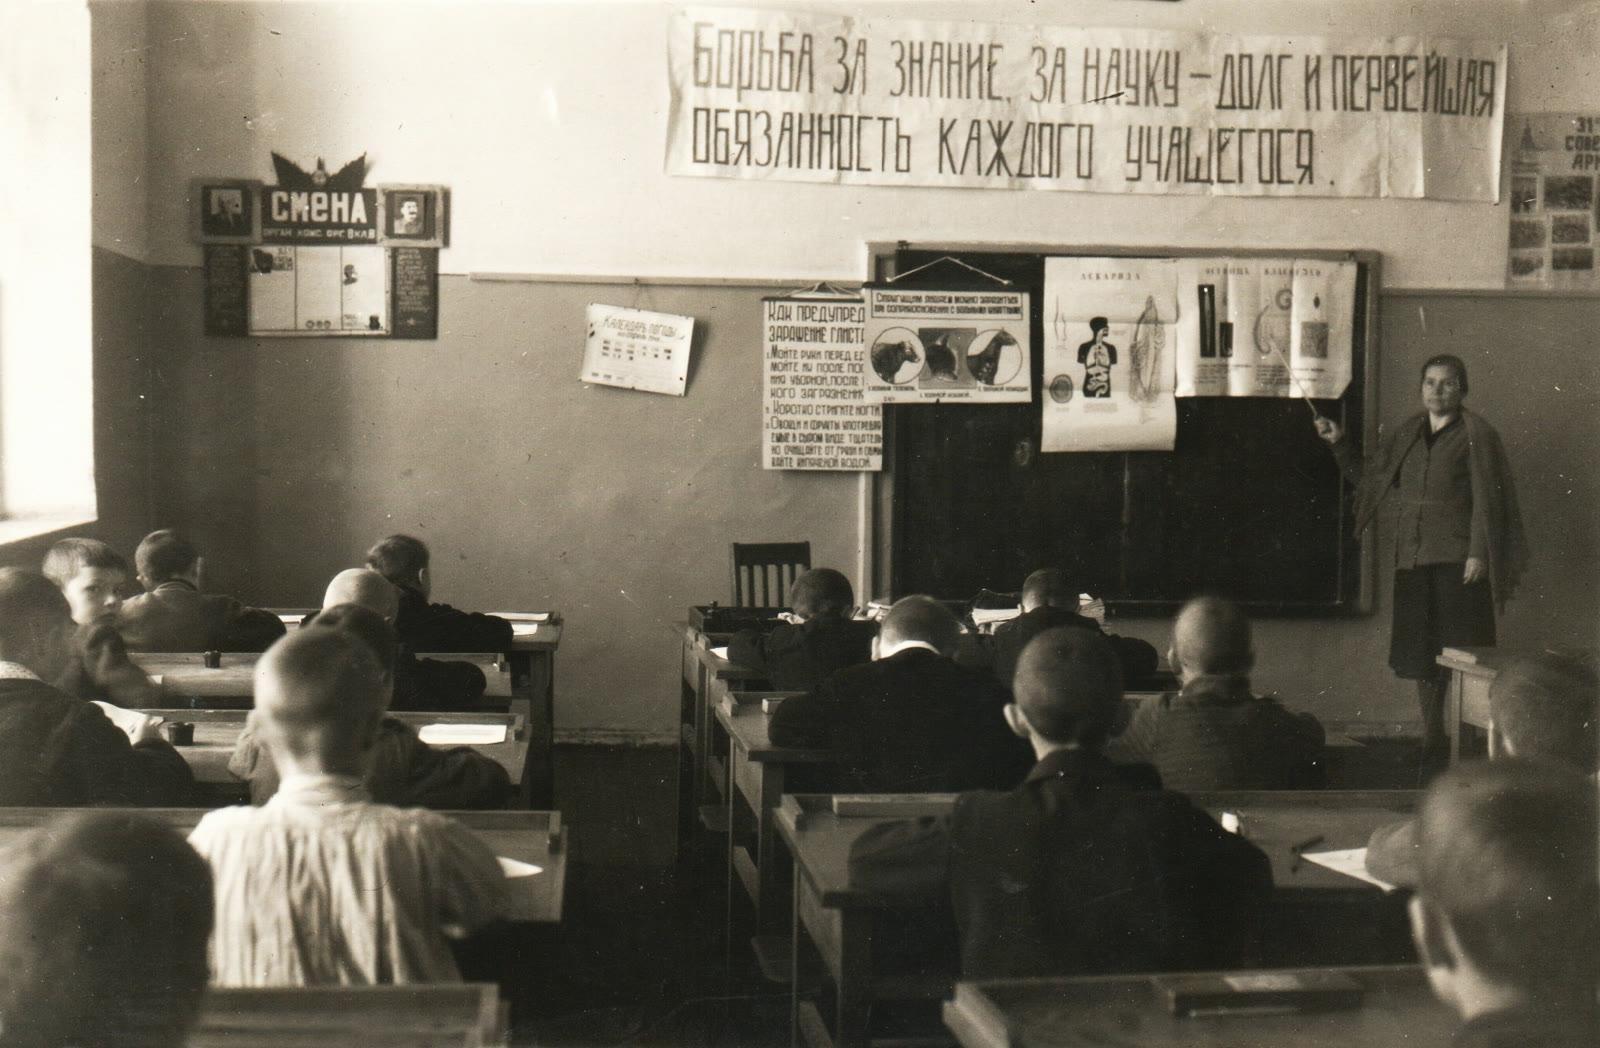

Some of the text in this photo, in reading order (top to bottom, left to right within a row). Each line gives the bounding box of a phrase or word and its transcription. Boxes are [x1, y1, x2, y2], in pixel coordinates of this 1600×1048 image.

[693, 22, 813, 102] БОРЬБА
[834, 37, 867, 96] ЗА
[1030, 46, 1066, 104] ЗА
[1083, 47, 1180, 107] НАУКУ
[1216, 54, 1293, 110] ДОЛГ
[1304, 54, 1320, 111] И
[1332, 50, 1496, 117] ПЕРВЕЙШАЯ
[692, 107, 911, 173] ОБЯЗАННОСТЬ
[938, 117, 1093, 180] КАЖДОГО
[1079, 272, 1141, 281] АСКАРИДА
[954, 296, 978, 304] МОЖНО
[768, 301, 865, 323] КАК ПРЕДУПРЕД
[770, 344, 798, 360] МОЙТЕ
[801, 350, 821, 360] РУКИ
[824, 350, 852, 361] ПЕРЕД
[770, 360, 798, 372] МОЙТЕ
[816, 362, 844, 373] ПОСЛЕ
[770, 387, 795, 399] КОГО
[773, 400, 813, 415] КОРОТКО
[815, 404, 854, 416] СТРИГИТЕ
[771, 416, 800, 430] ОВОЩИ
[810, 419, 840, 430] ФРУКТЫ
[825, 433, 844, 444] ВИДЕ
[771, 445, 781, 455] НО
[825, 446, 834, 456] ОТ
